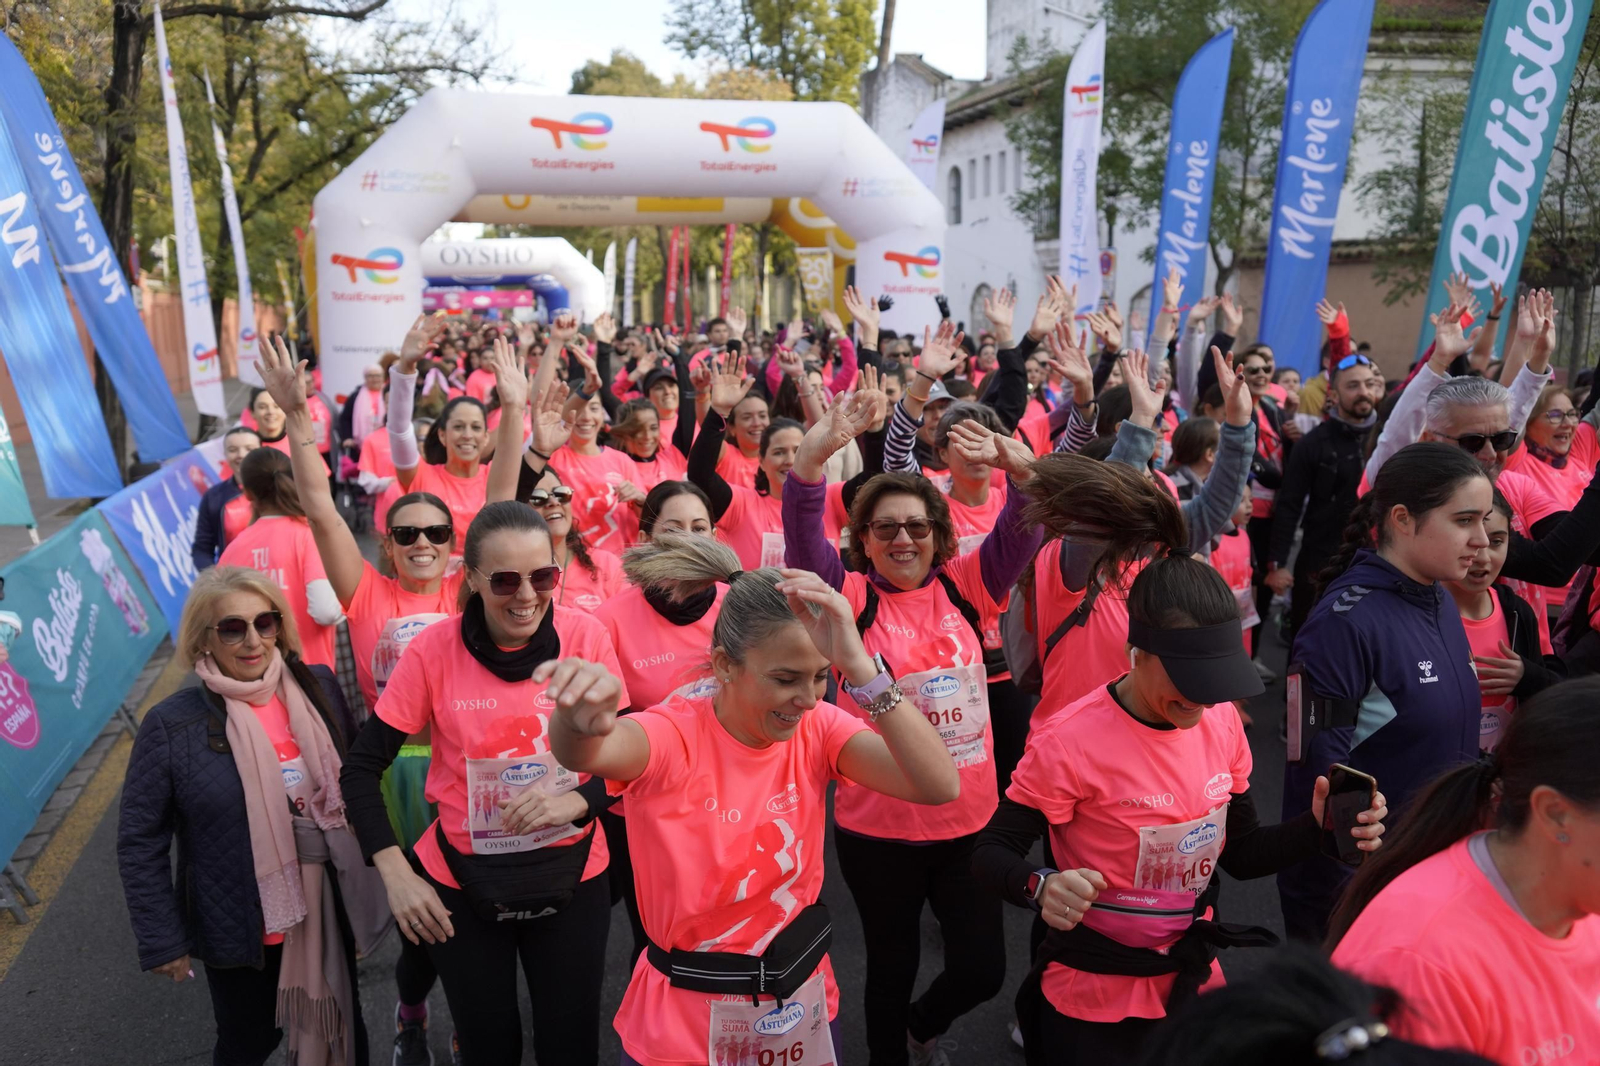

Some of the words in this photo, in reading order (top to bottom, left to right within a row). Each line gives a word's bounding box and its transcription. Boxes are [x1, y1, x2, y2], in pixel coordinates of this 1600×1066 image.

[1450, 0, 1574, 290] Batiste
[530, 157, 615, 172] TotalEnergies
[700, 160, 778, 174] TotalEnergies
[1279, 98, 1341, 260] Marlene
[1162, 140, 1210, 278] Marlene
[440, 245, 534, 267] OYSHO
[331, 290, 405, 305] TotalEnergies
[251, 547, 270, 569] TU
[633, 651, 675, 670] OYSHO
[1419, 675, 1439, 684] hummel
[924, 683, 959, 695] ASTURIANA
[451, 697, 498, 711] OYSHO
[3, 703, 33, 735] ESPAÑA
[928, 707, 963, 727] 016
[503, 769, 546, 782] ASTURIANA
[1118, 792, 1175, 809] OYSHO
[541, 825, 571, 841] Santander
[484, 839, 521, 849] OYSHO
[1148, 846, 1175, 855] SUMA
[497, 906, 558, 921] FILA
[721, 1024, 750, 1033] SUMA
[757, 1041, 804, 1066] 016
